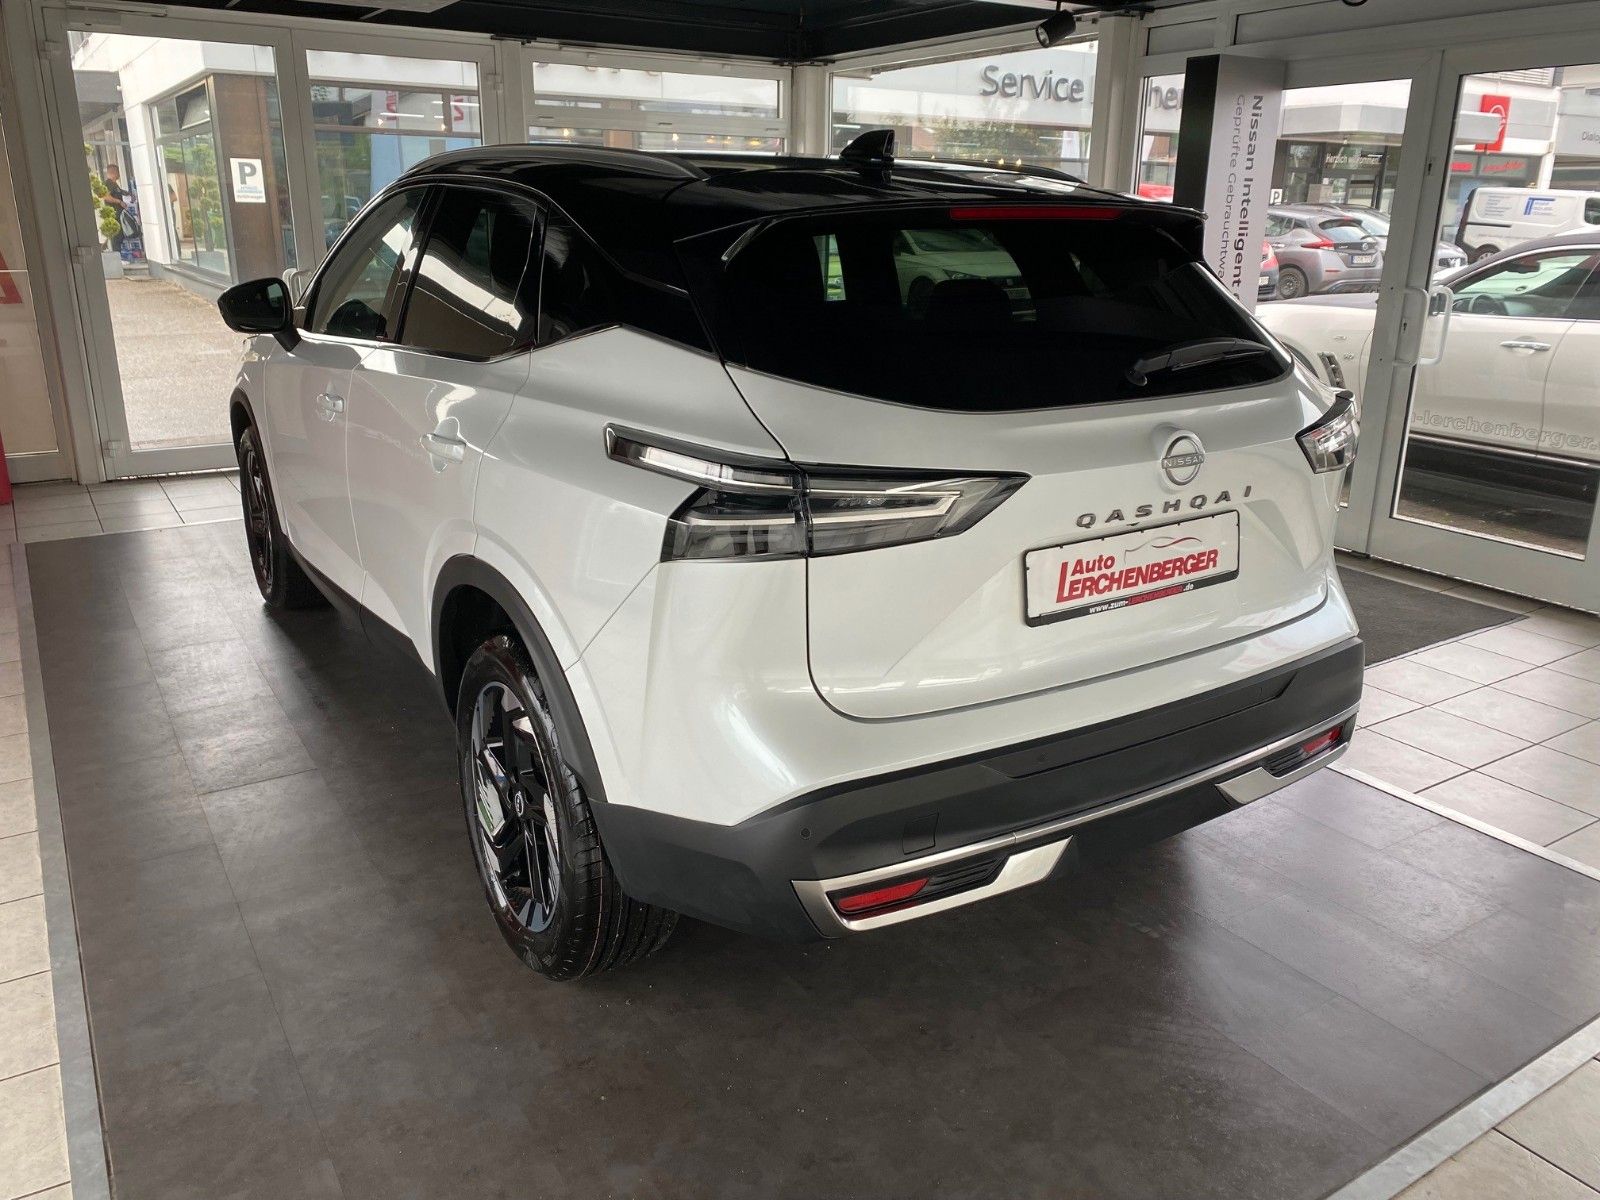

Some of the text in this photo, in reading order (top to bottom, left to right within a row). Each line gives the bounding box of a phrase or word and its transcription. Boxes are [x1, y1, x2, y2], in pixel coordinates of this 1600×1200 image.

[980, 65, 1085, 102] Service
[1230, 94, 1245, 168] Geprüfte
[1245, 95, 1263, 171] Nissan
[237, 161, 257, 185] P
[1217, 172, 1236, 279] Gebrauchtwa
[1232, 177, 1253, 288] Intelligent
[1410, 409, 1600, 449] -lerchenberger.
[1163, 455, 1204, 467] NISSAN
[1075, 485, 1252, 529] QASHQAI
[1055, 549, 1219, 604] LERCHENBERGER
[1070, 554, 1116, 577] Auto
